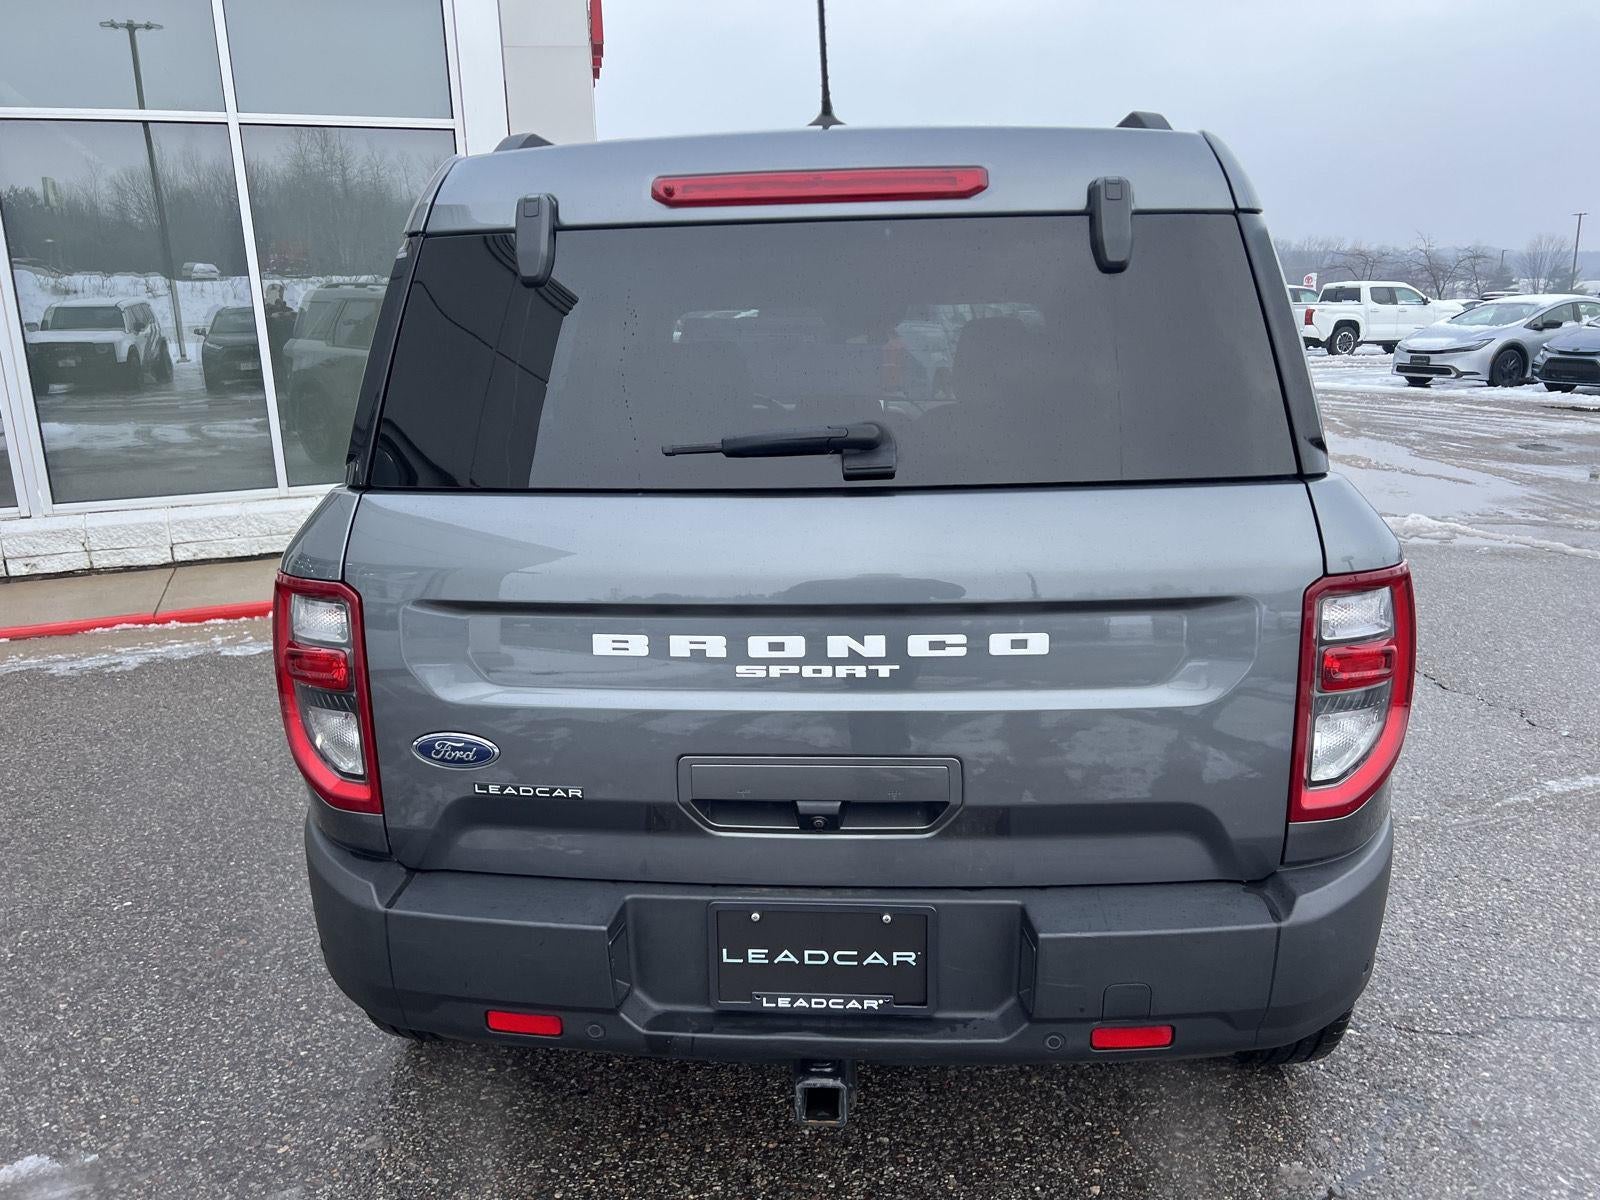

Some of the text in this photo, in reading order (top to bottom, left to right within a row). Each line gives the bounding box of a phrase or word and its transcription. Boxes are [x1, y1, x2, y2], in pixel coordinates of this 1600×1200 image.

[592, 632, 1049, 658] BRONCO
[735, 665, 900, 678] SPORT
[431, 740, 477, 761] Ford
[474, 783, 583, 798] LEADCAR
[722, 948, 917, 966] LEADCAR
[762, 997, 879, 1010] LEADCAR
